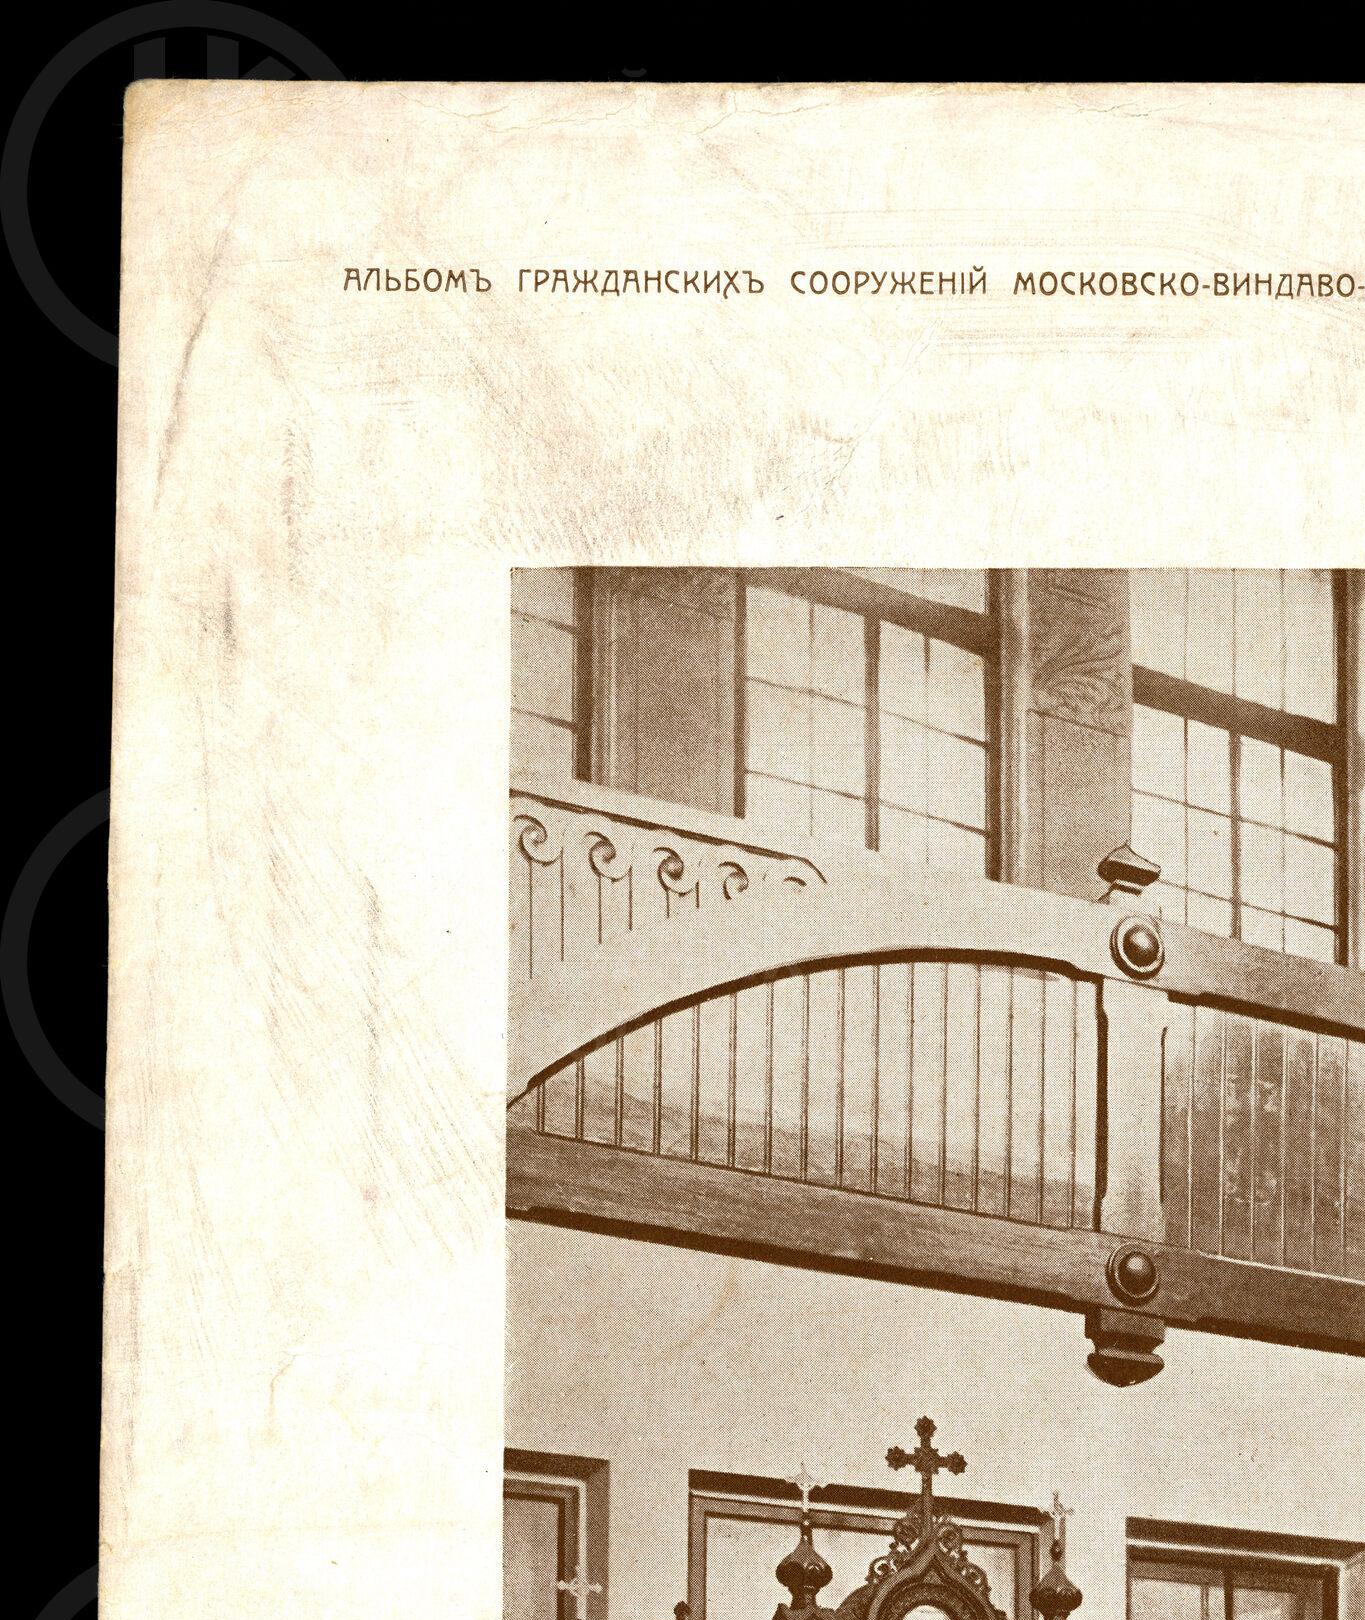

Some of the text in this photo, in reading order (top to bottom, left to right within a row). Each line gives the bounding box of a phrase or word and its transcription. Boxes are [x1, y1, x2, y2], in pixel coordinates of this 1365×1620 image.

[344, 267, 492, 293] АЛЬБОМЪ
[518, 268, 765, 299] ГРАЖДАНСКИХЪ
[790, 265, 987, 295] СООРУЖЕНІЙ
